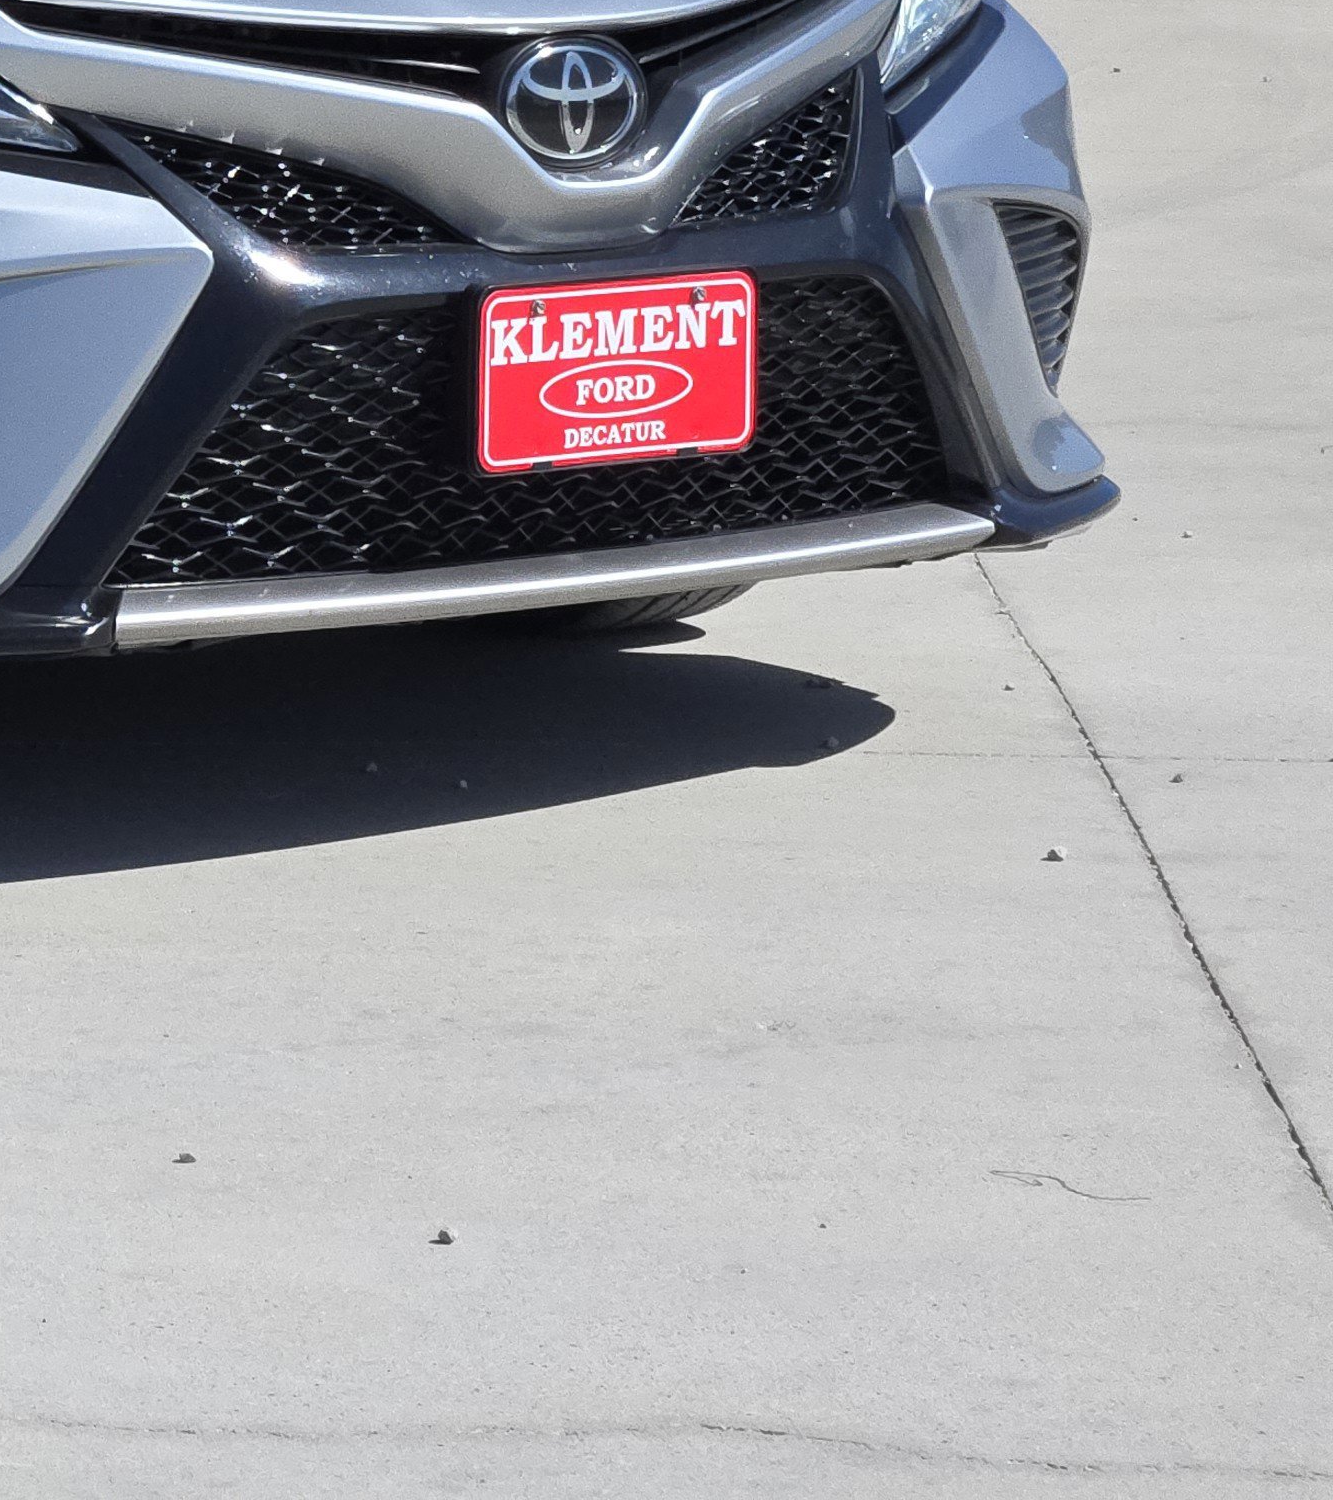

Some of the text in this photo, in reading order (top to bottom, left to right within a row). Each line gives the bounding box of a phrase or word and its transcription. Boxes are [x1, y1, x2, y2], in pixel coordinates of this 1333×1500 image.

[490, 299, 746, 366] KLEMENT
[575, 374, 656, 406] FORD
[564, 420, 666, 449] DECATUR
